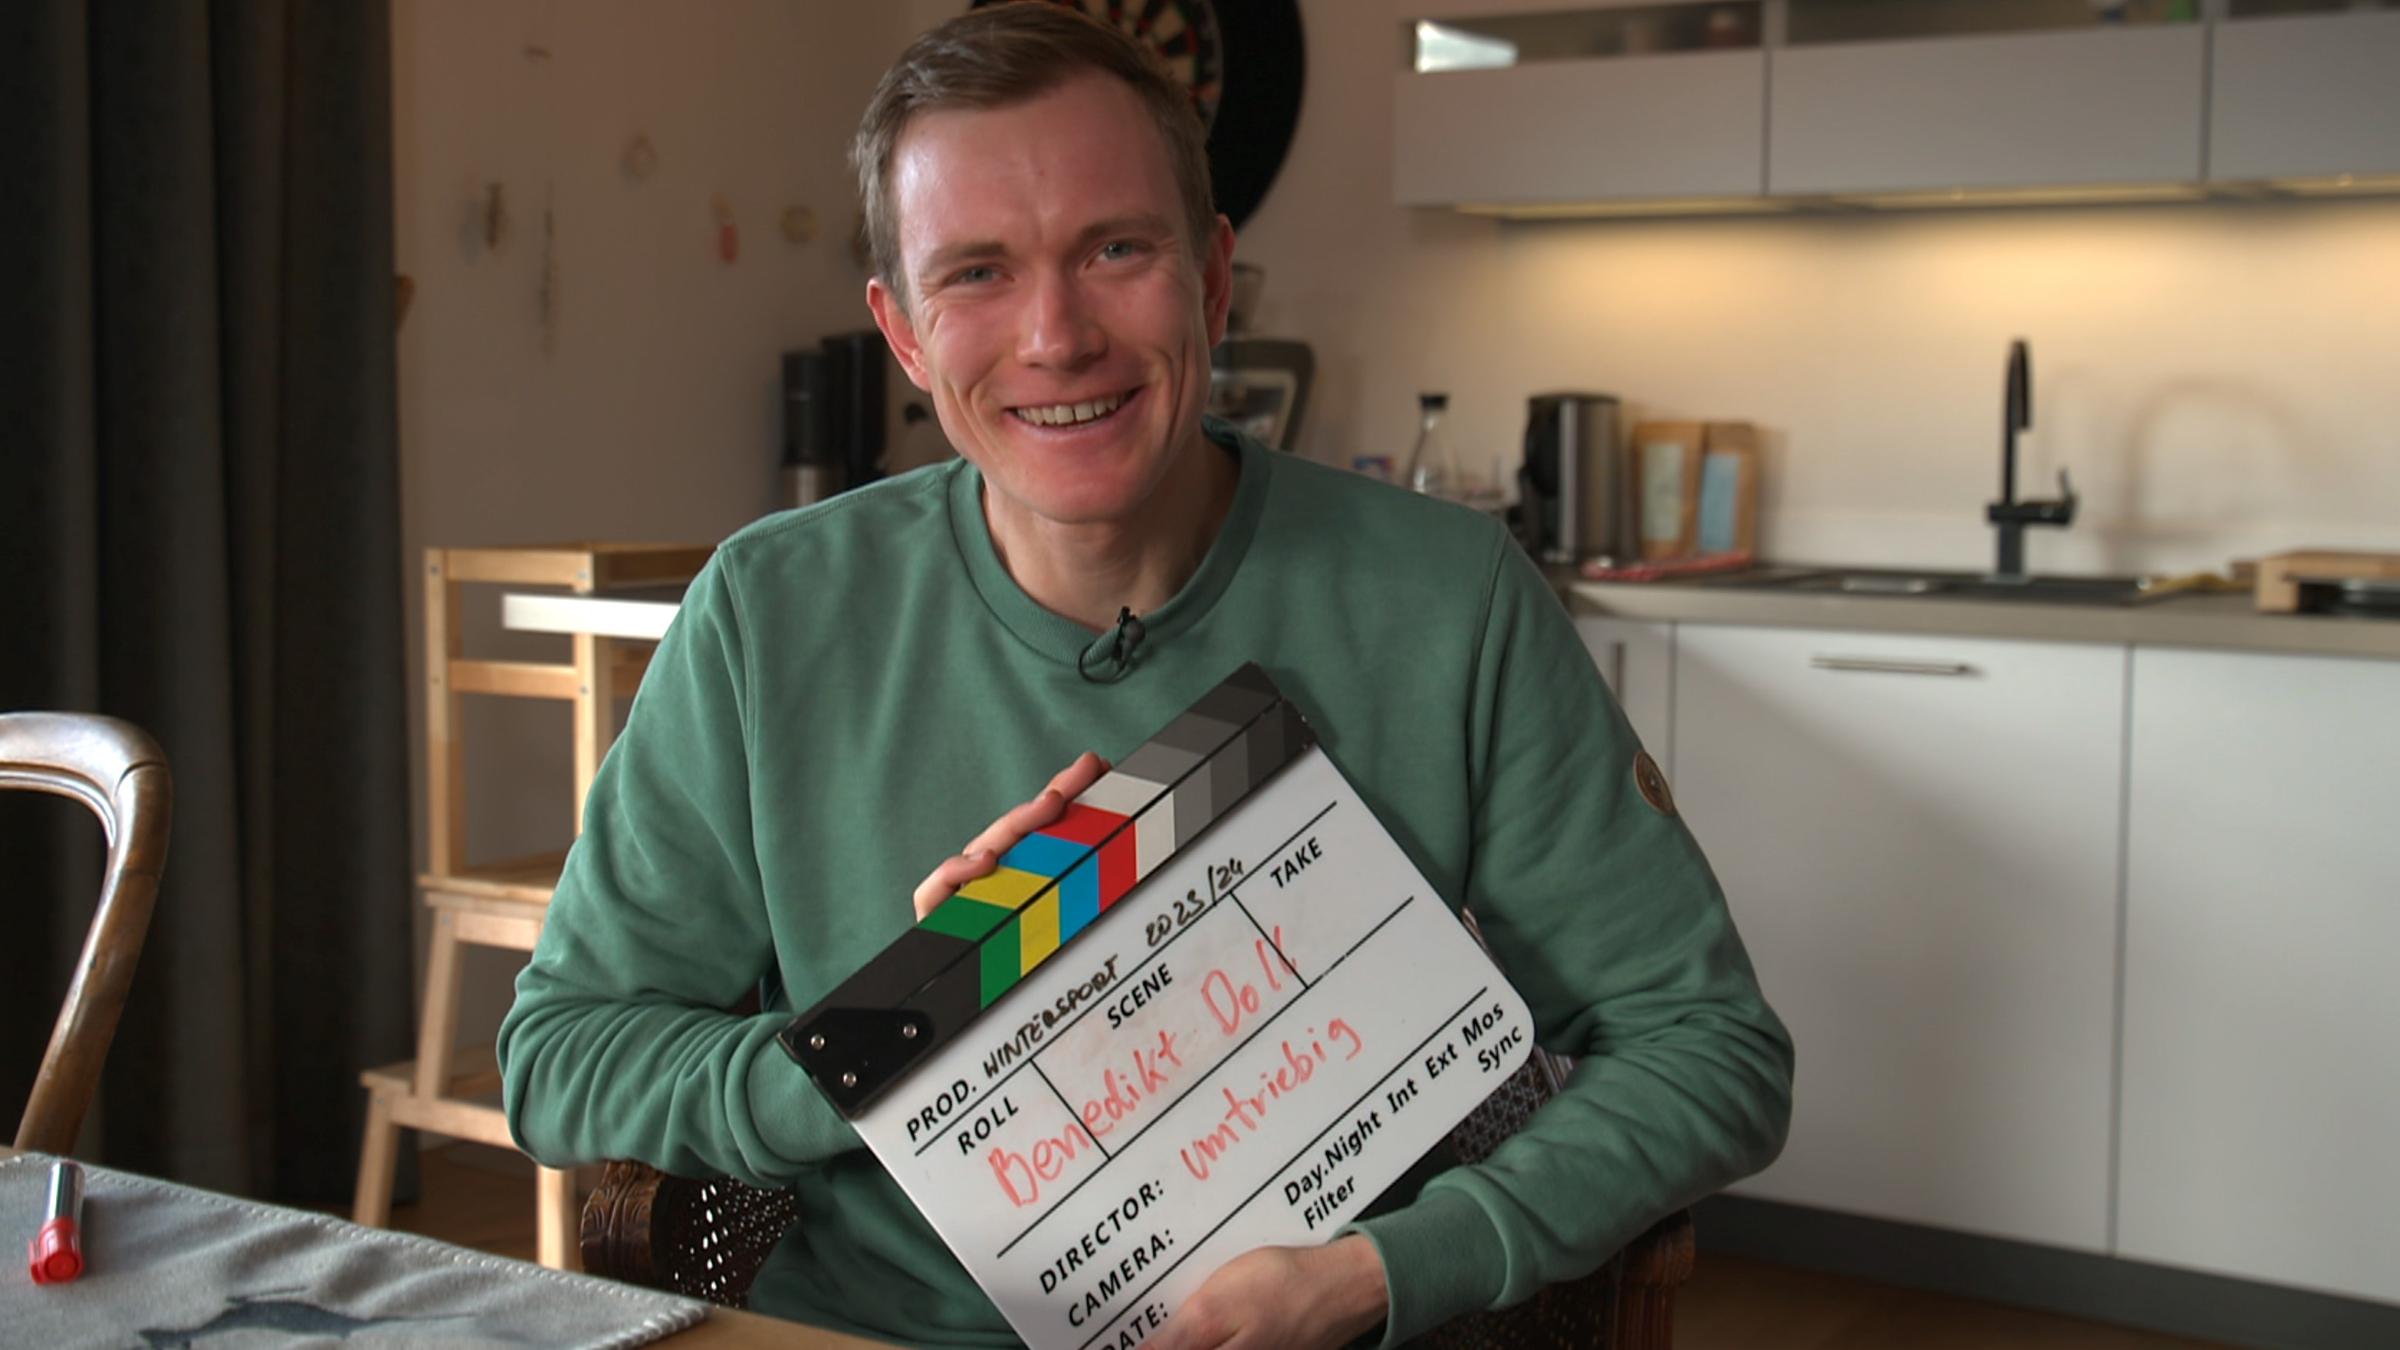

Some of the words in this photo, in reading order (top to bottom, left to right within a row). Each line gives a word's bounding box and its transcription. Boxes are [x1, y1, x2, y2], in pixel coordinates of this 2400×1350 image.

[1270, 837, 1322, 888] TAKE
[982, 954, 1118, 1079] WINTERSPORT
[1107, 963, 1173, 1030] SCENE
[988, 1030, 1182, 1207] Benedikt
[1201, 925, 1297, 1036] Doll
[1386, 1078, 1419, 1114] Int
[1425, 1043, 1458, 1079] Ext
[1461, 1003, 1504, 1046] Mos
[1477, 1026, 1523, 1072] Sync
[906, 1079, 977, 1142] PROD.
[957, 1097, 1019, 1155] ROLL
[1039, 1179, 1164, 1295] DIRECTOR:
[1304, 1176, 1356, 1231] Filter
[1068, 1229, 1174, 1327] CAMERA:
